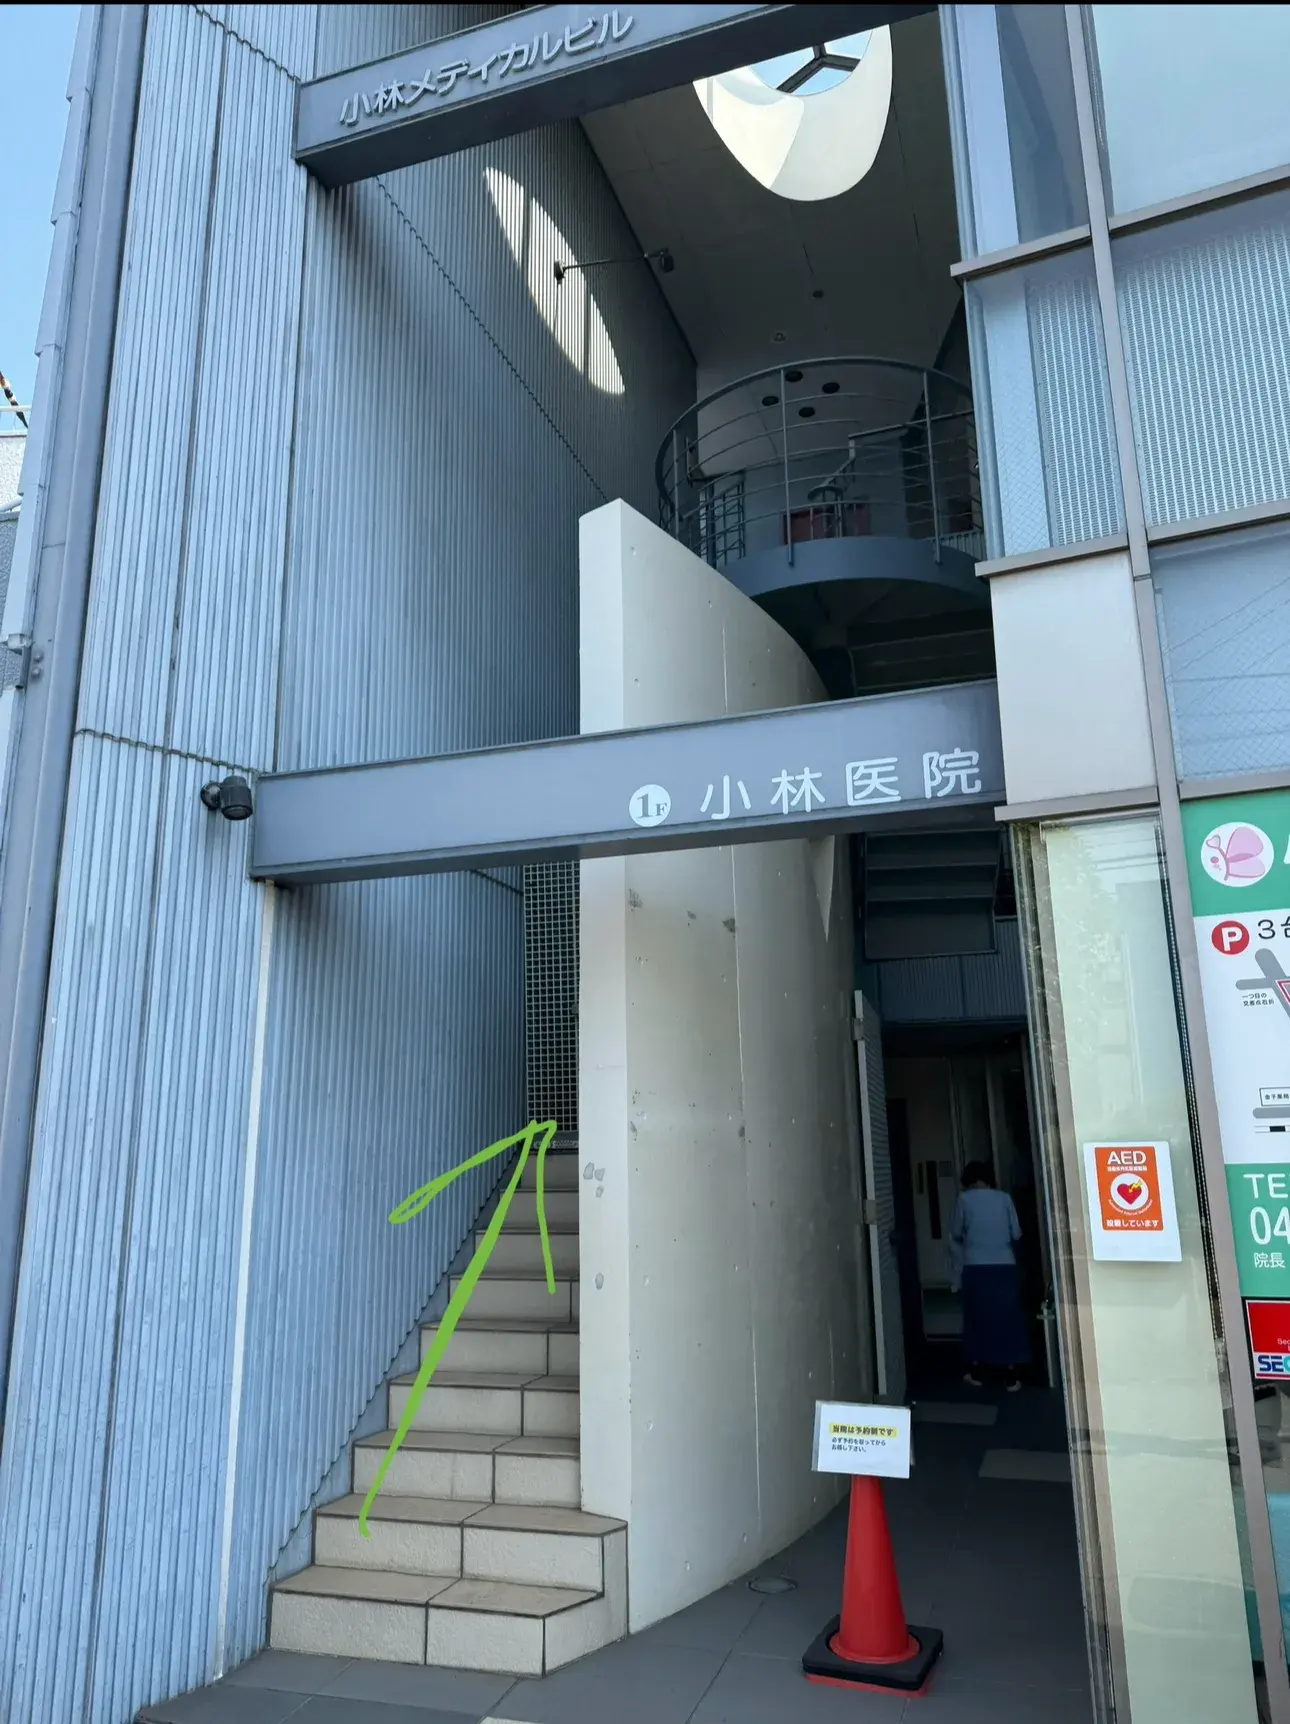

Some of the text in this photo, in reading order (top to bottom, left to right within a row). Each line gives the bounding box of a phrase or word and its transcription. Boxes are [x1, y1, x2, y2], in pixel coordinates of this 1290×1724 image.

[338, 9, 634, 126] 小林メディカルビル
[634, 747, 982, 820] 1F 小林医院
[1221, 926, 1243, 952] P
[1107, 1150, 1147, 1165] AED
[1243, 1173, 1290, 1199] TE
[1106, 1218, 1159, 1228] 設置しています
[1253, 1251, 1286, 1268] 院長
[832, 1424, 894, 1437] 当院は予約制です
